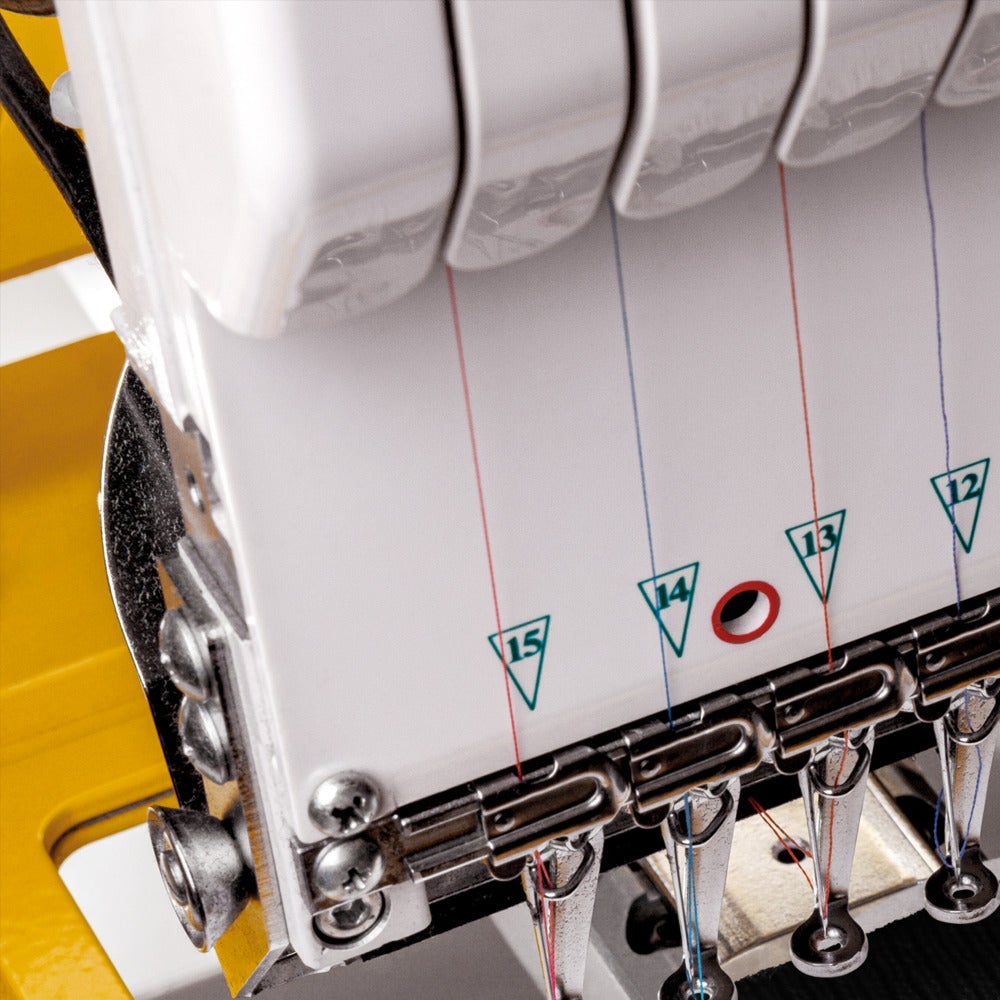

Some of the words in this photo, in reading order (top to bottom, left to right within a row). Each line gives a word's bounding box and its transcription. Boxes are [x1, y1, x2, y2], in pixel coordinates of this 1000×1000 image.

[946, 472, 981, 505] 12
[800, 523, 836, 556] 13
[656, 576, 690, 609] 14
[506, 628, 543, 664] 15
